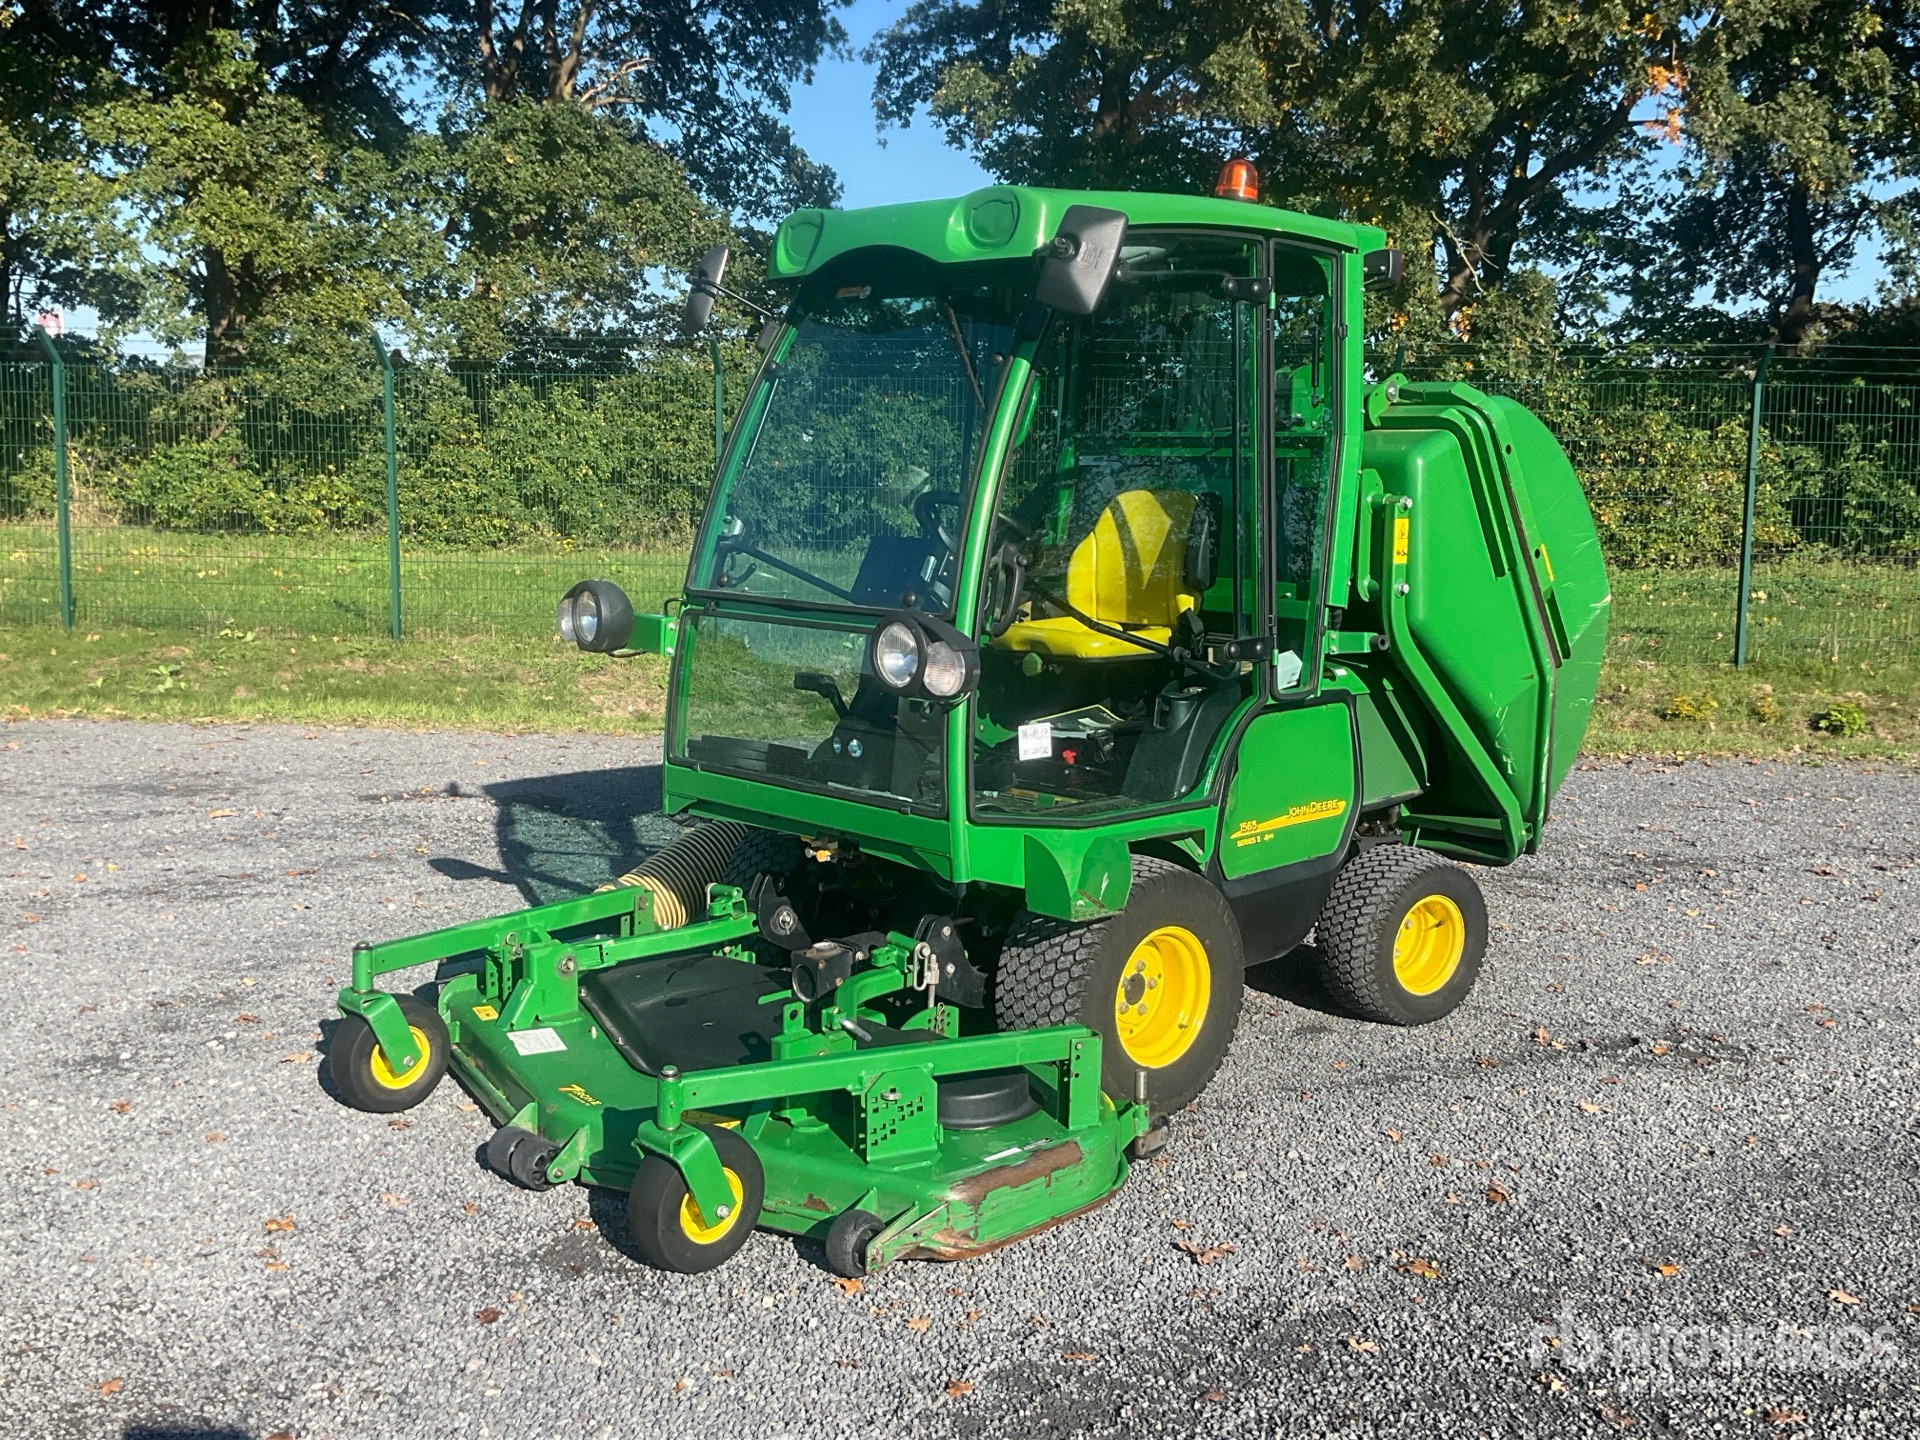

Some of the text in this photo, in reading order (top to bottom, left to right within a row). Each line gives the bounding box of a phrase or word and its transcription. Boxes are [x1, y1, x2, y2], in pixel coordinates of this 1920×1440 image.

[1288, 799, 1338, 818] JOHN DEERE
[1240, 820, 1257, 832] 1565
[1237, 837, 1256, 847] SERIES
